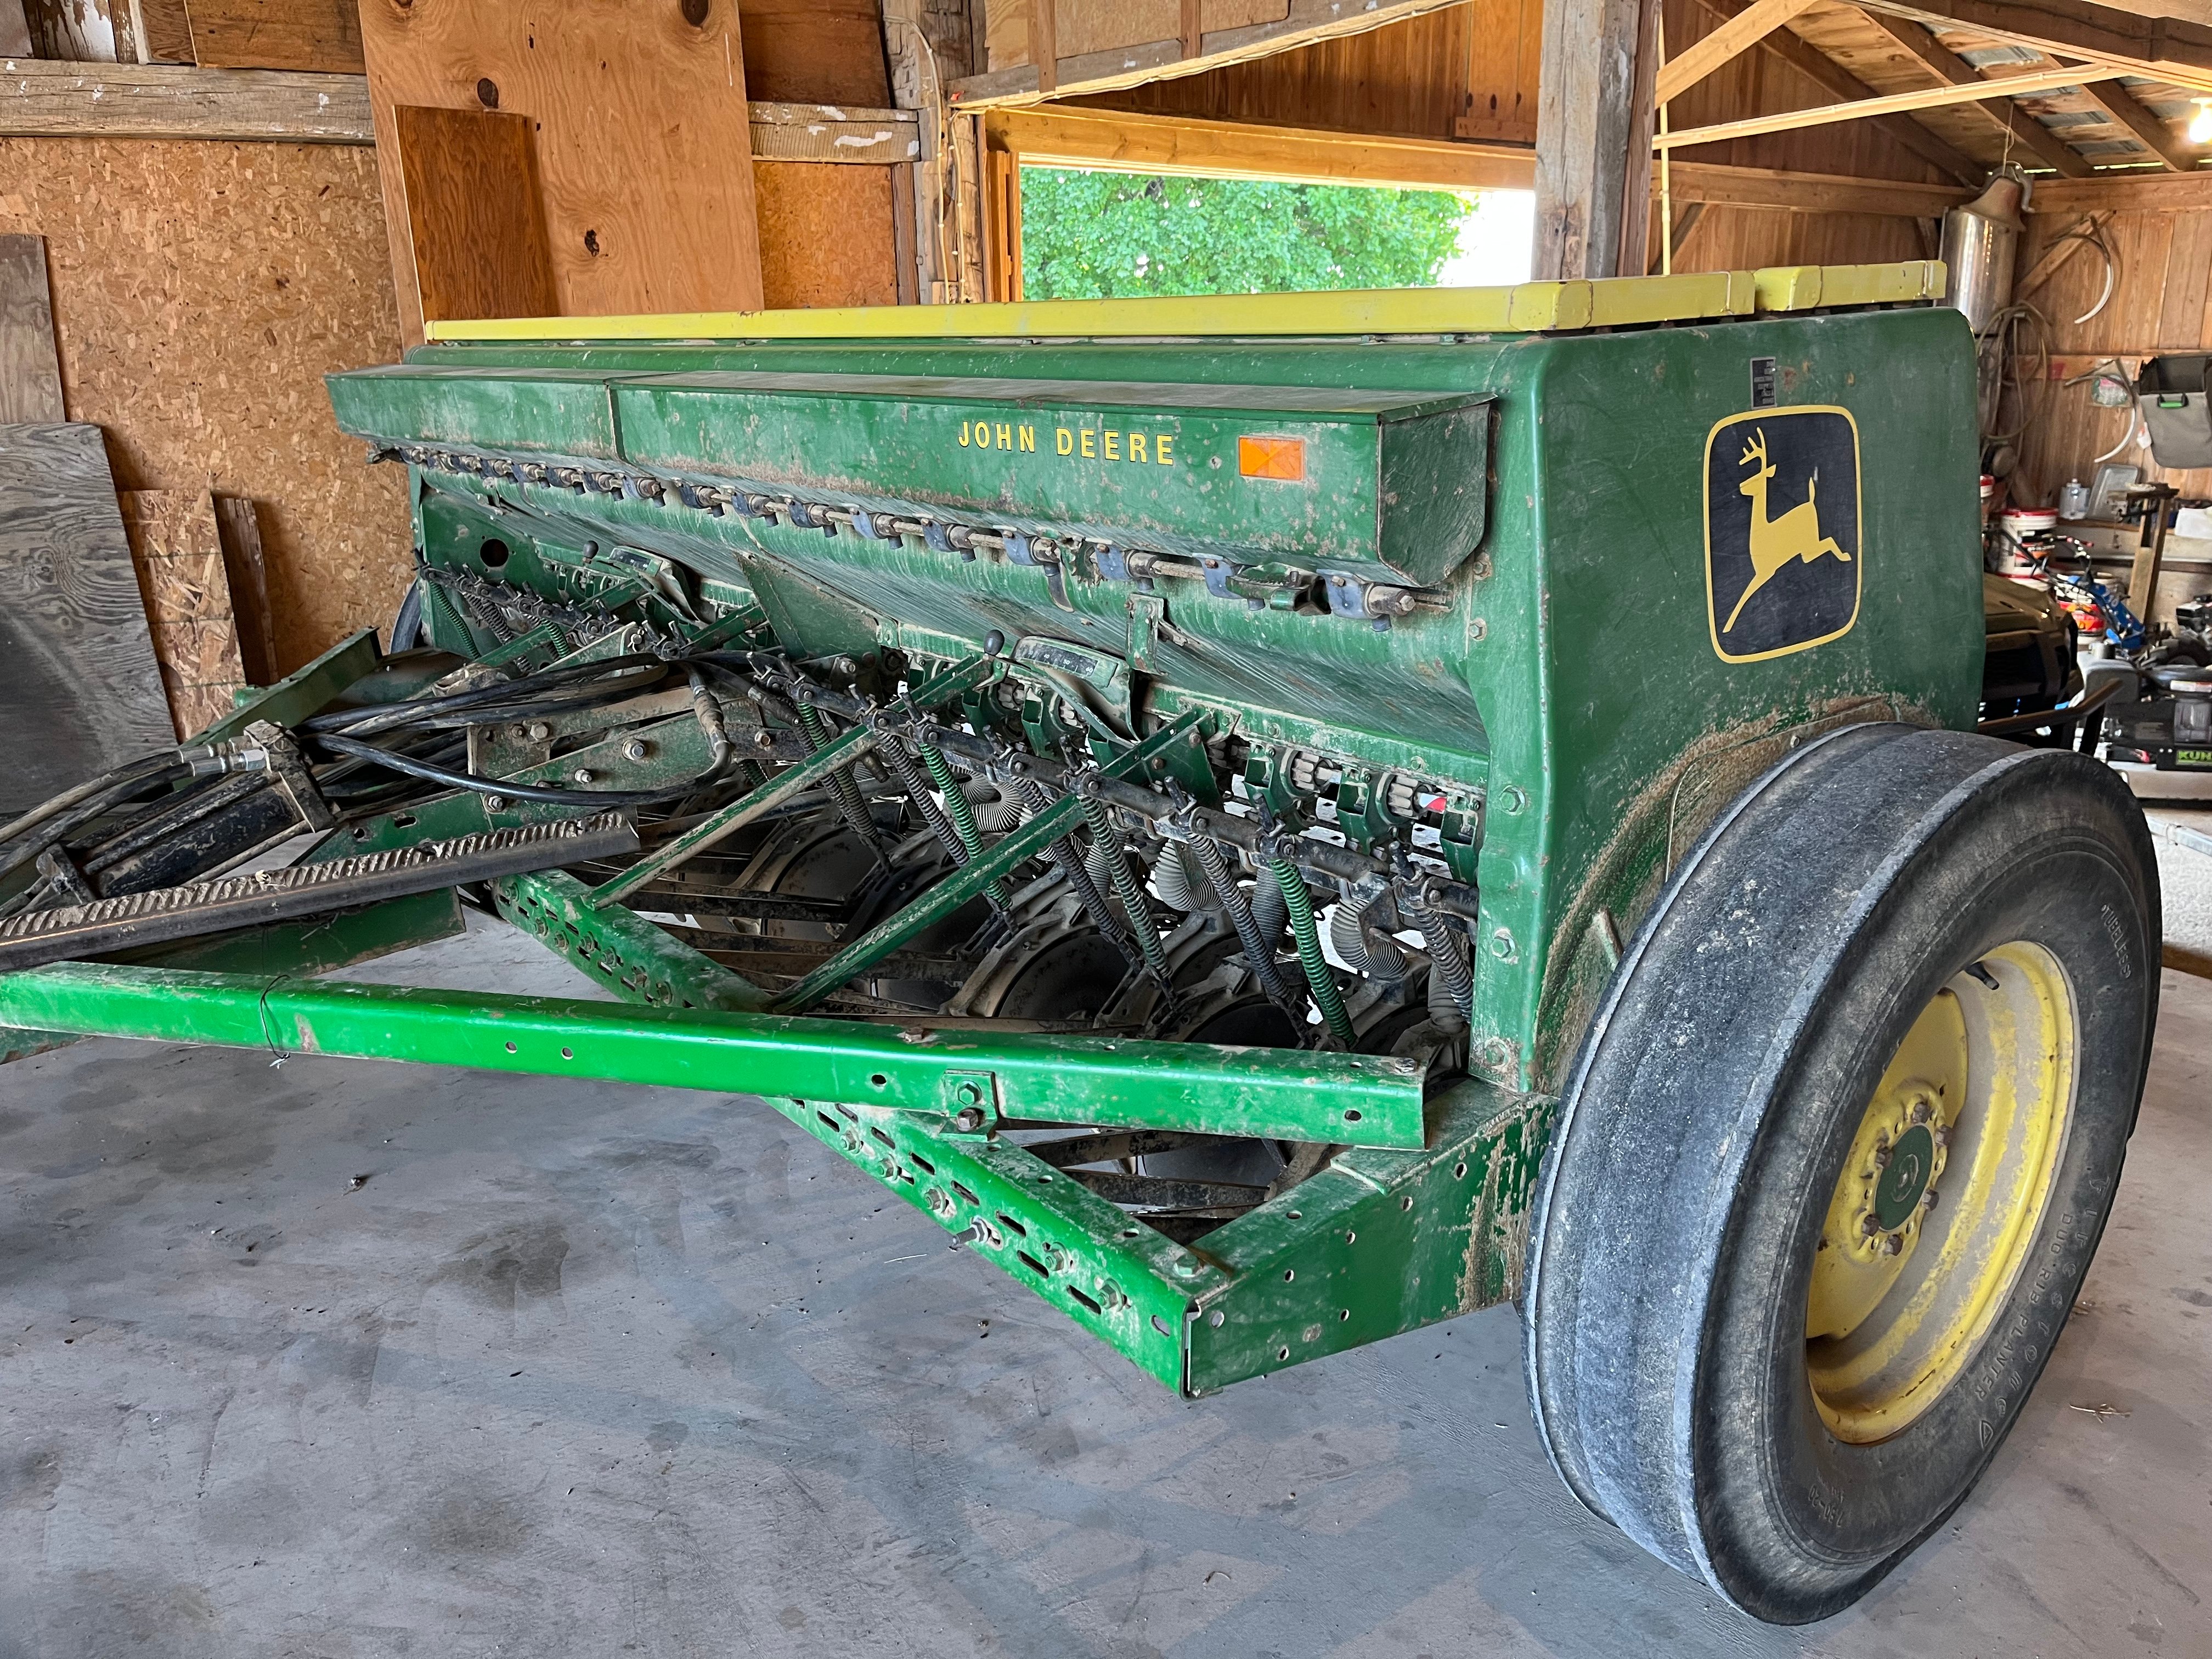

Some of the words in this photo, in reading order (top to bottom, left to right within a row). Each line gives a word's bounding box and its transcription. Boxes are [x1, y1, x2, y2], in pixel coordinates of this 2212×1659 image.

[958, 421, 1035, 453] JOHN
[1056, 427, 1173, 465] DEERE
[2101, 904, 2131, 977] TUBELESS
[2030, 1267, 2053, 1304] RIB
[1975, 1313, 2029, 1401] PLANTER
